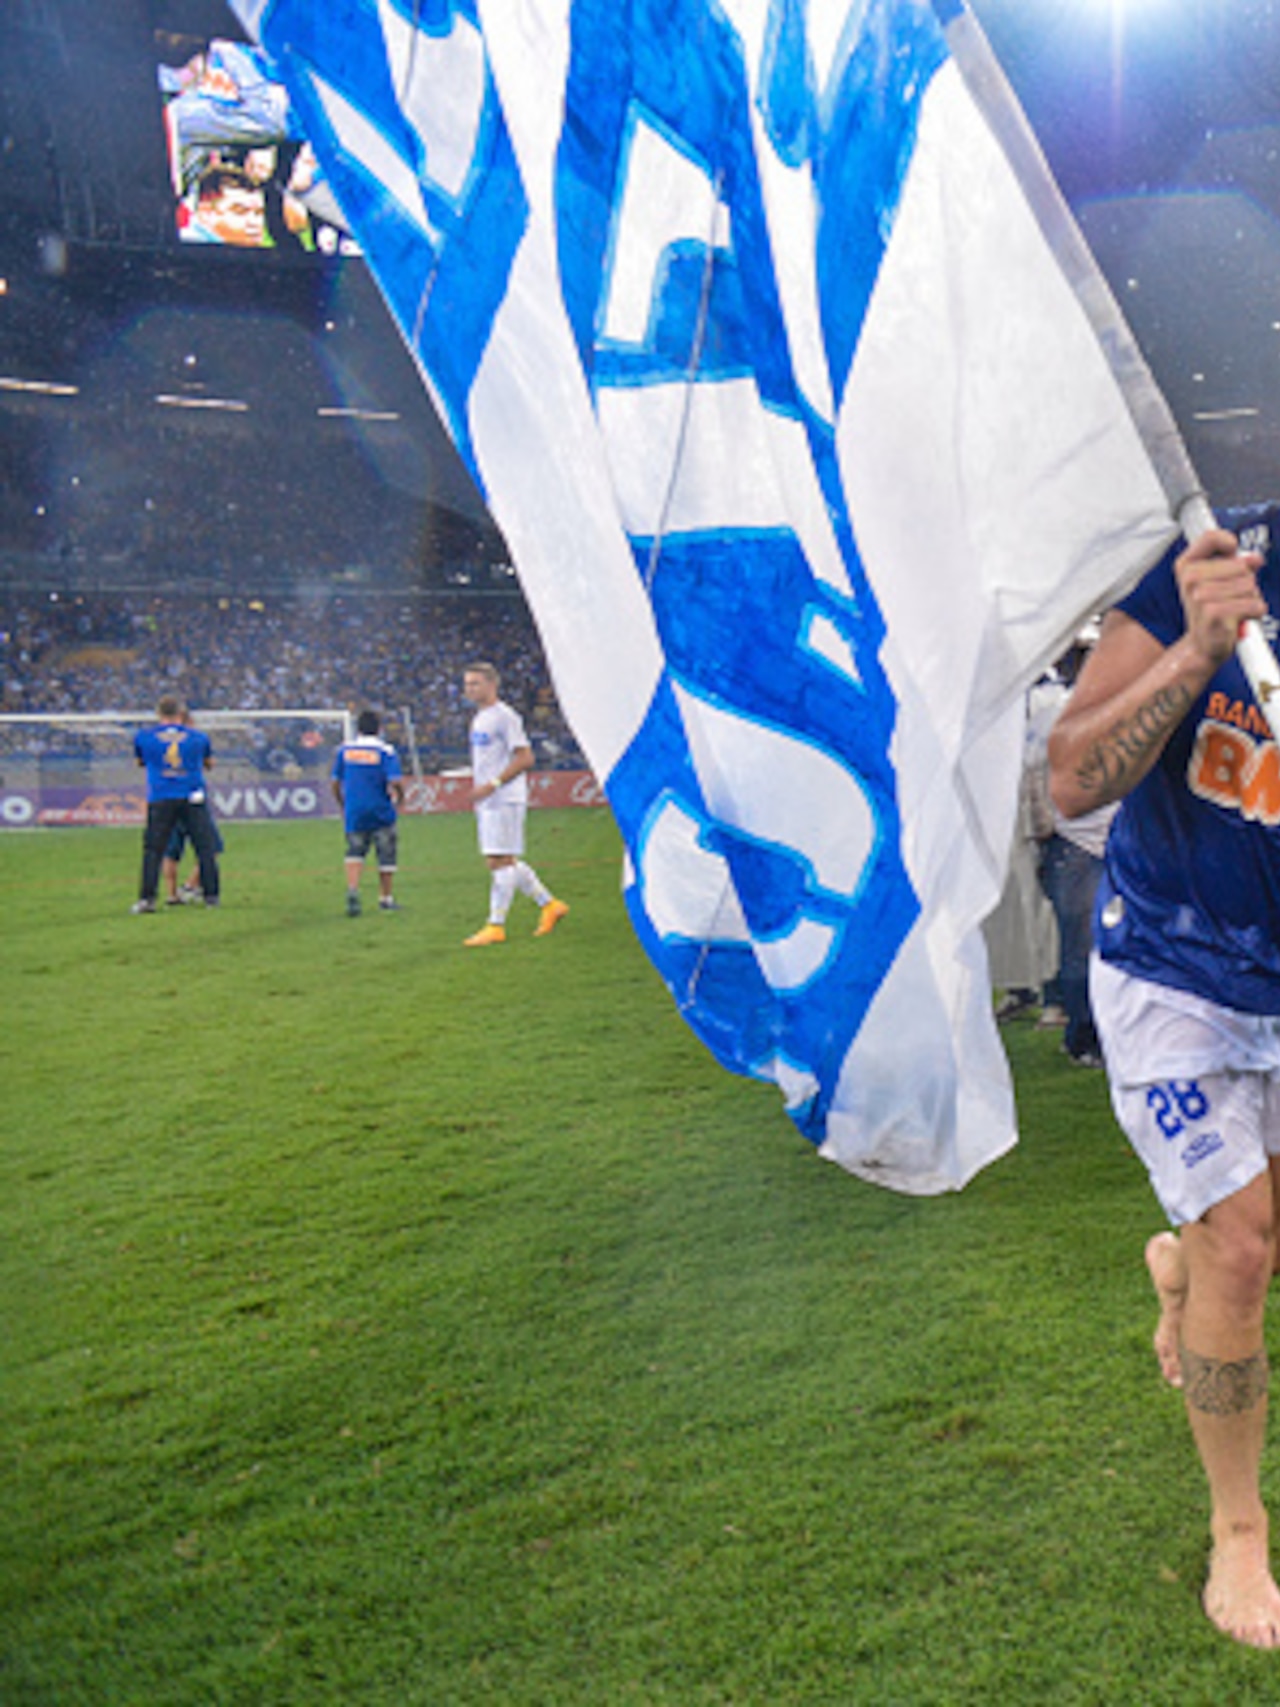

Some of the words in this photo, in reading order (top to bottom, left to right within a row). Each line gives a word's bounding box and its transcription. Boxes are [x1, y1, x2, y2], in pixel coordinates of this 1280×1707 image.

[1206, 691, 1274, 738] BAN
[214, 787, 317, 815] VIVO
[1147, 1080, 1209, 1141] 28
